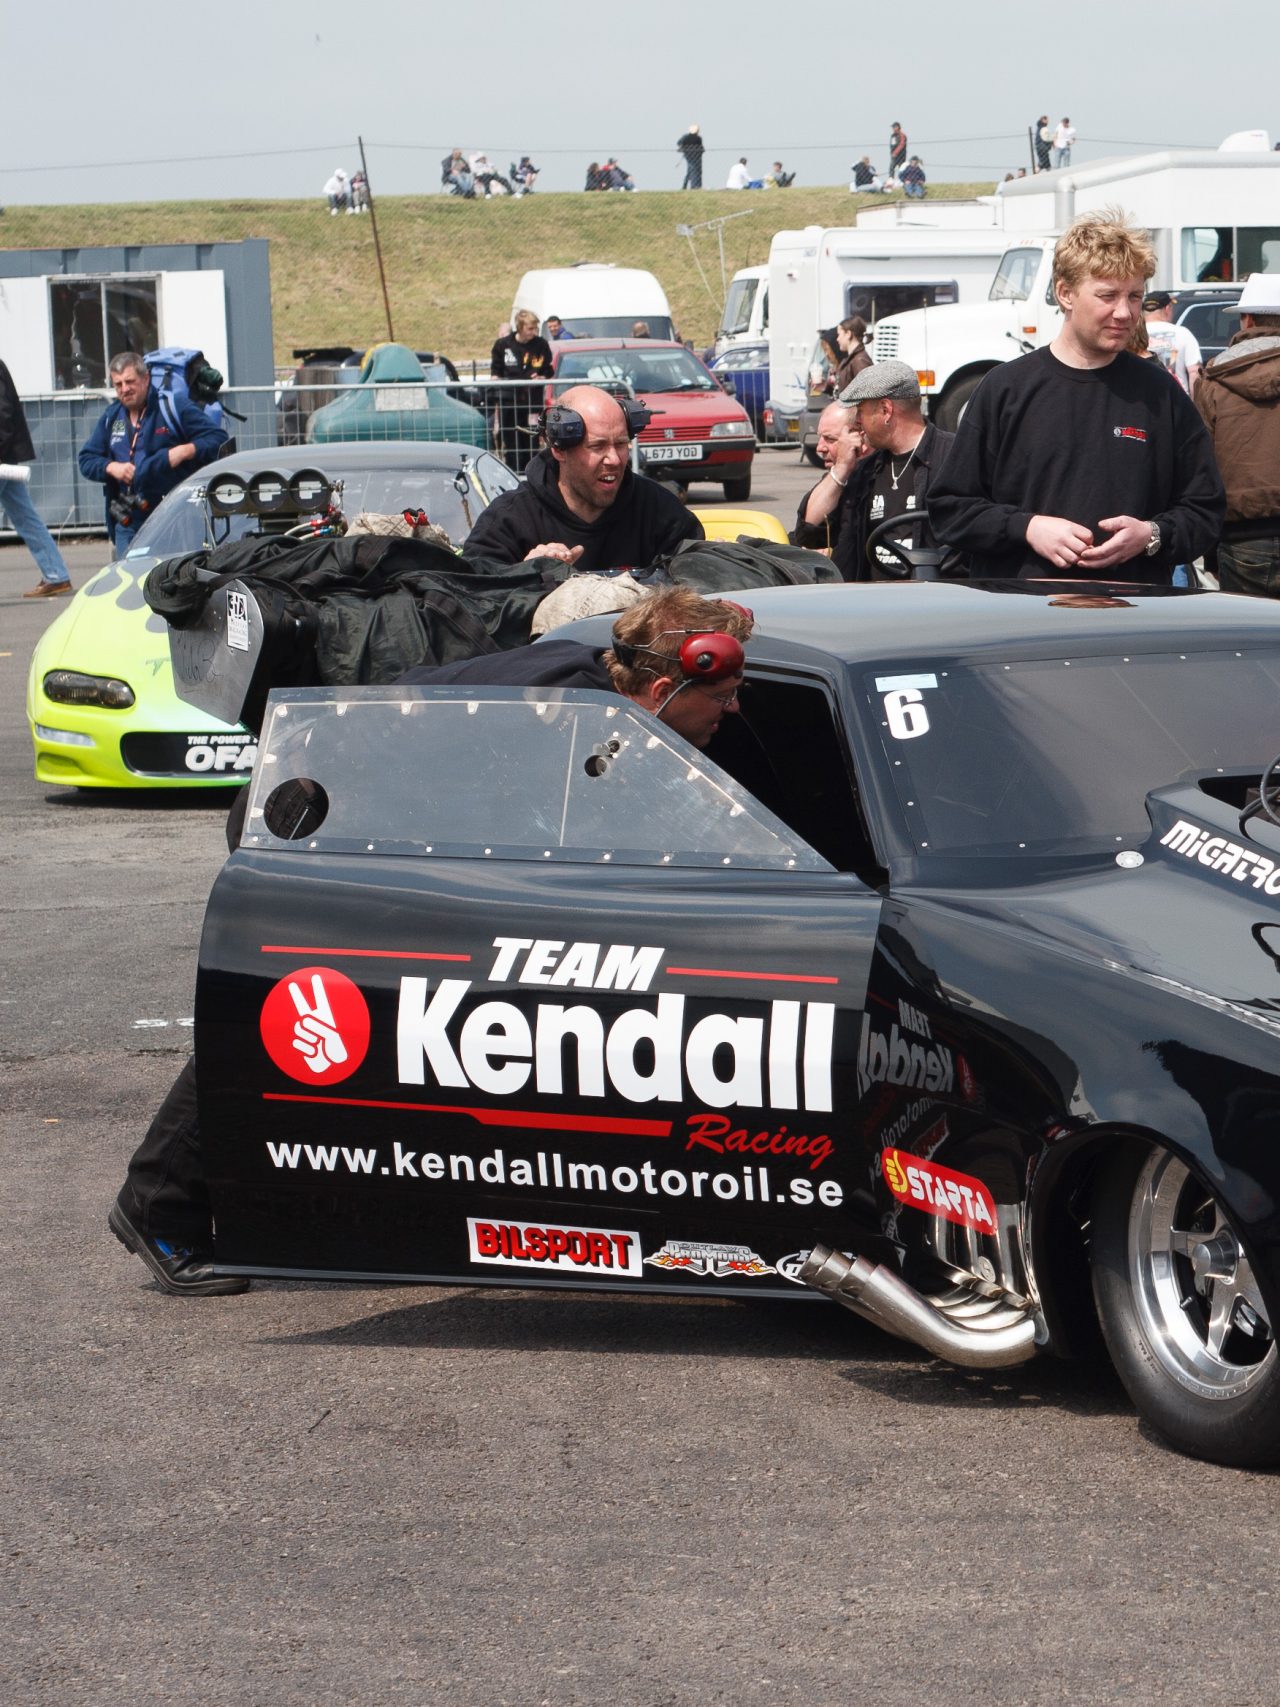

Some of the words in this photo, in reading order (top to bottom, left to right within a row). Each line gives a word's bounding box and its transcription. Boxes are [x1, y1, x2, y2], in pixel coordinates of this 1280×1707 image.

[187, 735, 208, 745] THE
[210, 735, 251, 745] POWER
[883, 688, 930, 740] 6
[488, 937, 666, 992] TEAM
[397, 976, 836, 1113] Kendall
[685, 1113, 836, 1171] Racing
[265, 1140, 844, 1207] www.kendallmotoroil.se
[906, 1169, 993, 1226] STARTA
[475, 1221, 634, 1270] BILSPORT
